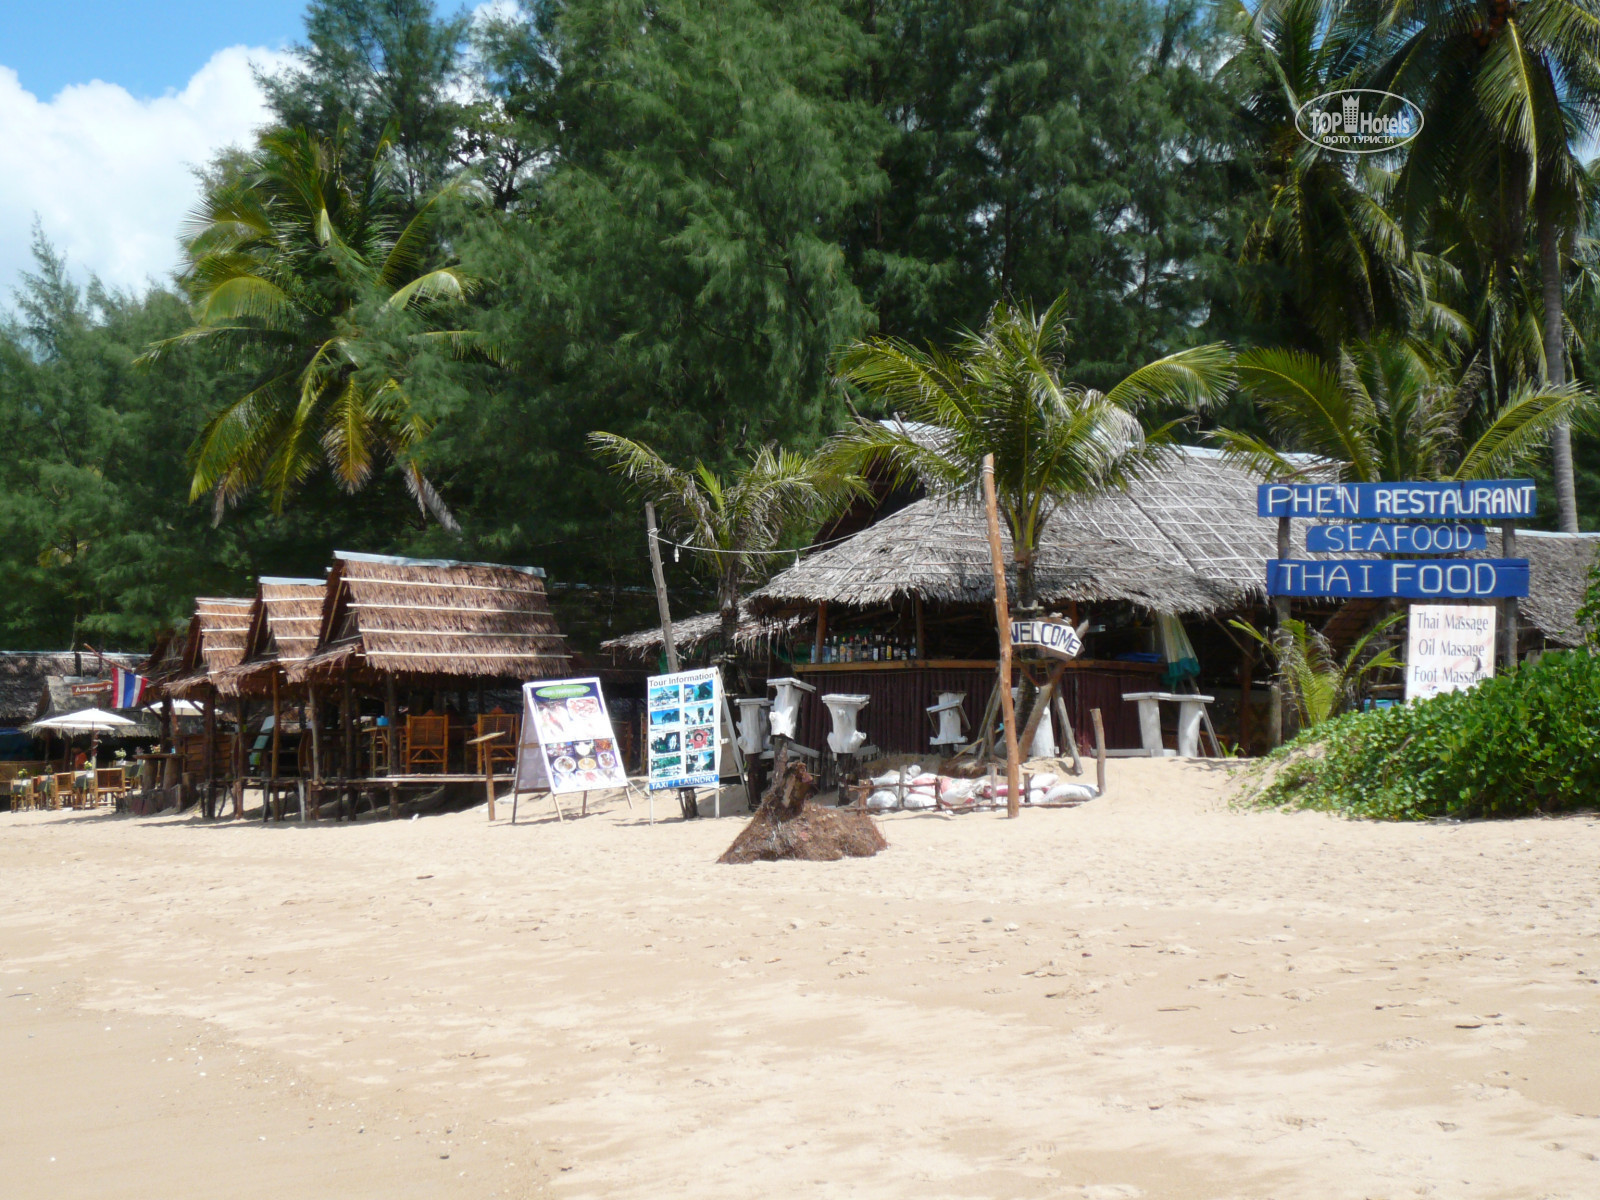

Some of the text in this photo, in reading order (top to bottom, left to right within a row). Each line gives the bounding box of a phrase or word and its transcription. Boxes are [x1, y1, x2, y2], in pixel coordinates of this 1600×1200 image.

[1268, 486, 1535, 514] PHEN RESTAURANT
[1325, 525, 1472, 552] SEAFOOD
[1279, 563, 1496, 594] THAI FOOD
[1417, 612, 1489, 636] Thai Massage
[1419, 638, 1485, 662] Oil Massage
[669, 672, 714, 685] Information
[1414, 666, 1437, 682] Foot
[651, 781, 669, 790] TAXI
[679, 775, 716, 786] LAUNDRY
